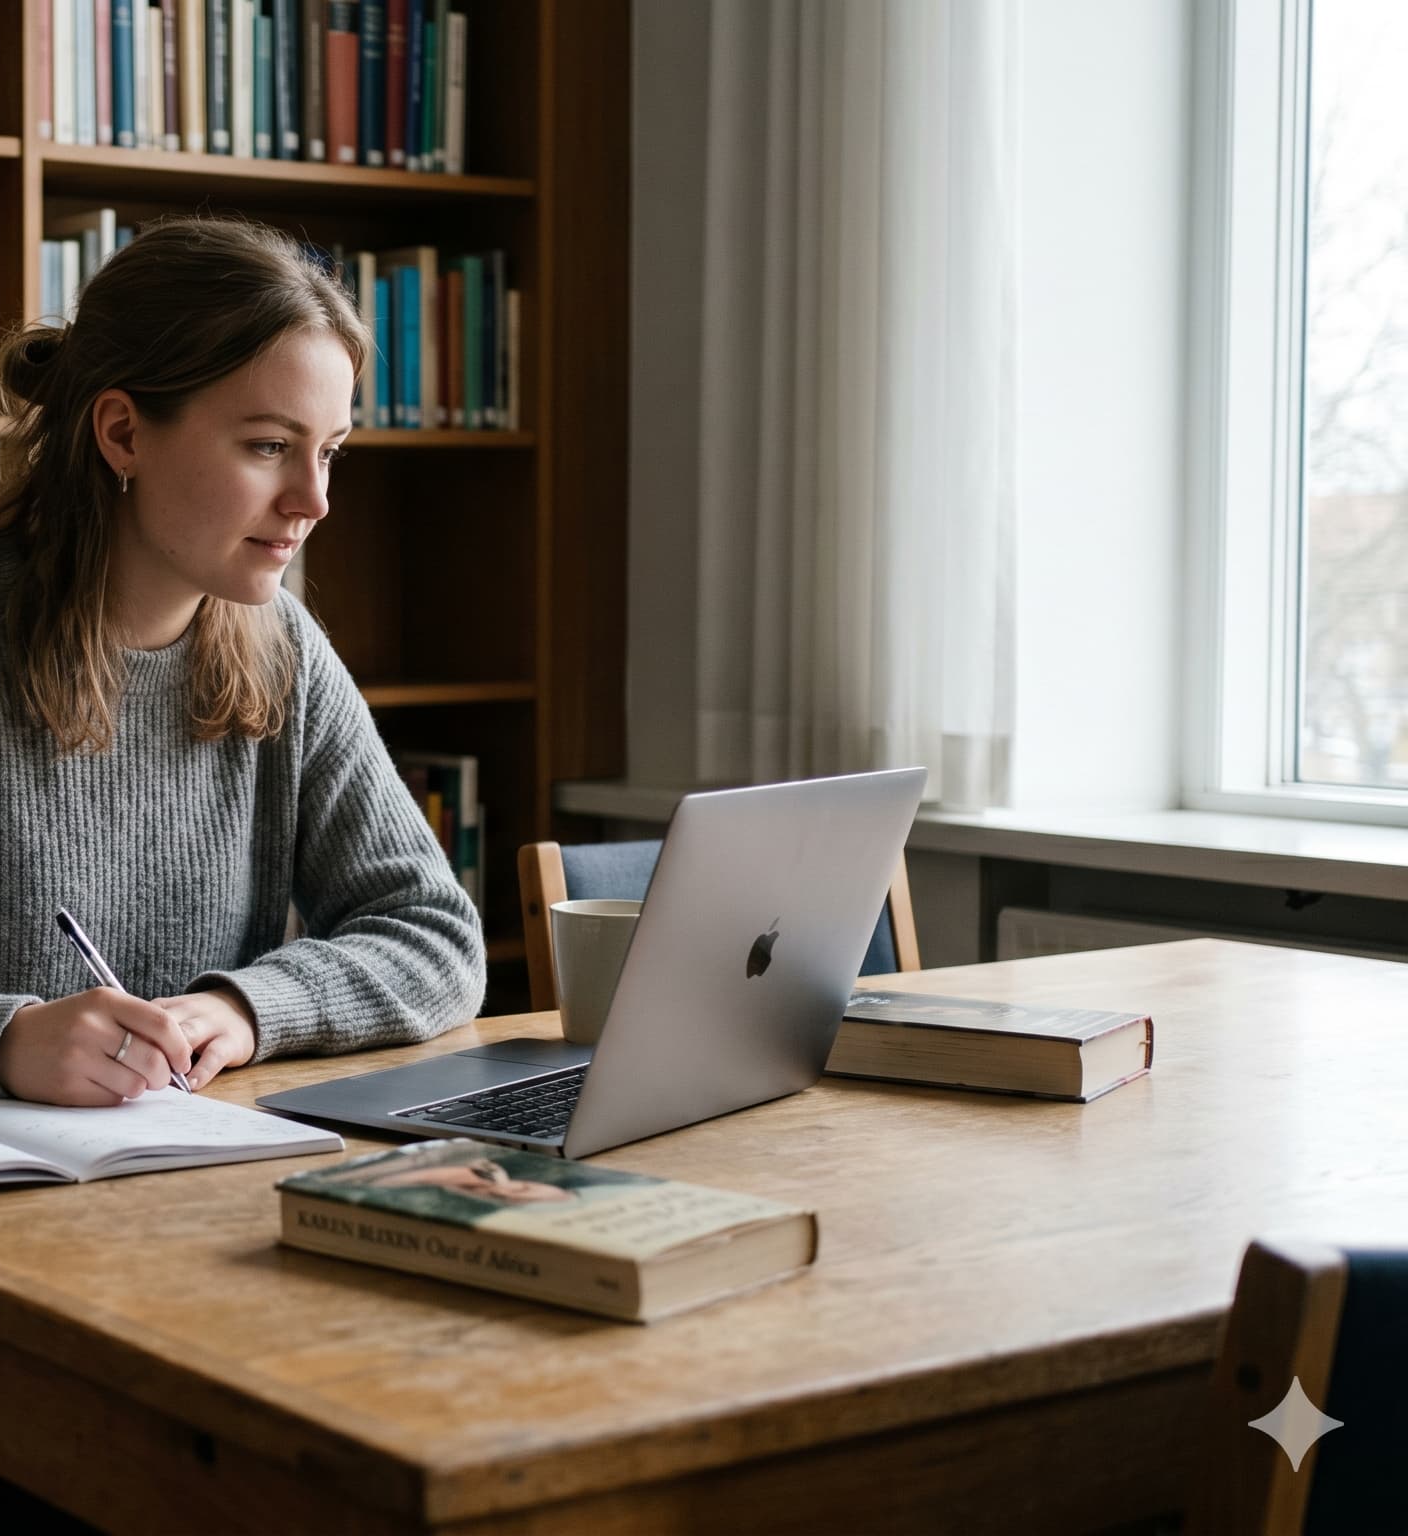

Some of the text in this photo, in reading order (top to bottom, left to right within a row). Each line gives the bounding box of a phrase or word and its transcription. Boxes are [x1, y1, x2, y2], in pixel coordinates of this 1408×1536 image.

[297, 1210, 540, 1278] KAREN BLIXEN Out of Africa
